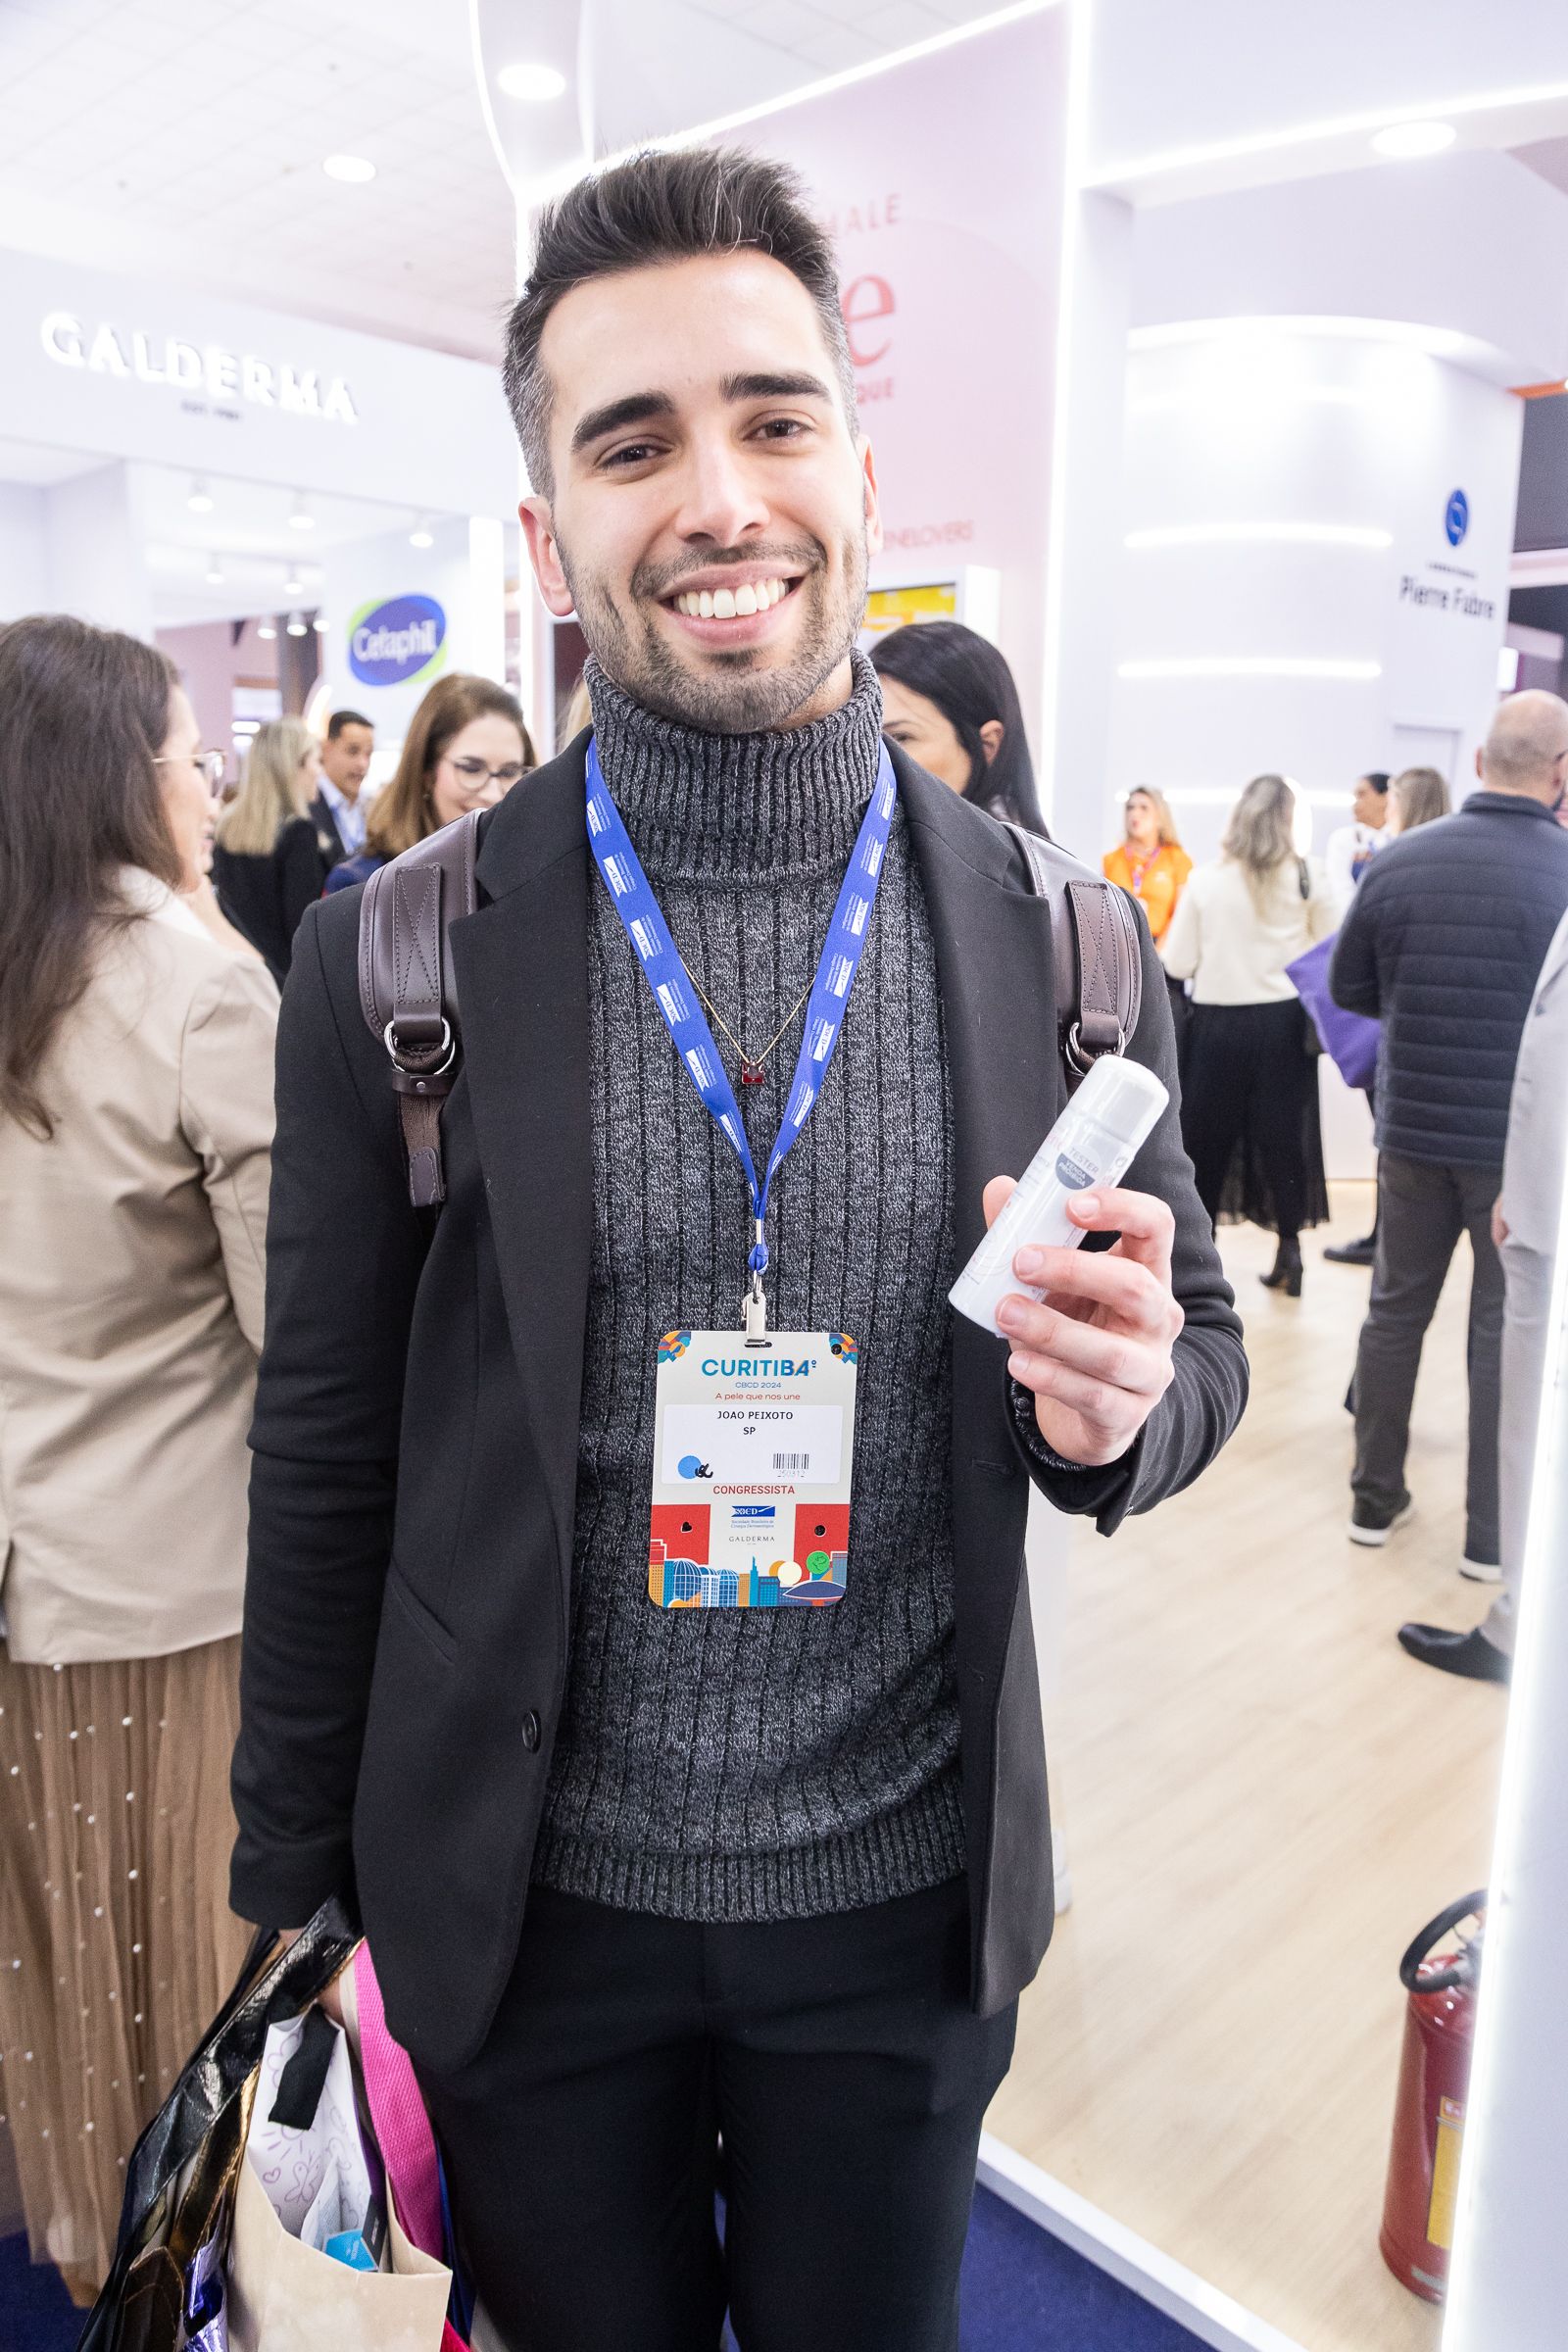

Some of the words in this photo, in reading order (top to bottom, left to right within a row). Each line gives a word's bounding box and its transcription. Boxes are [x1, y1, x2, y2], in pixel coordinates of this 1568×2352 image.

[41, 312, 360, 424] GALDERMA
[353, 618, 437, 666] Cetaphil
[1069, 1148, 1099, 1173] TESTER
[717, 1410, 745, 1420] JOAO
[748, 1411, 794, 1420] PEIXOTO
[743, 1426, 757, 1436] SP
[713, 1485, 796, 1494] CONGRESSISTA
